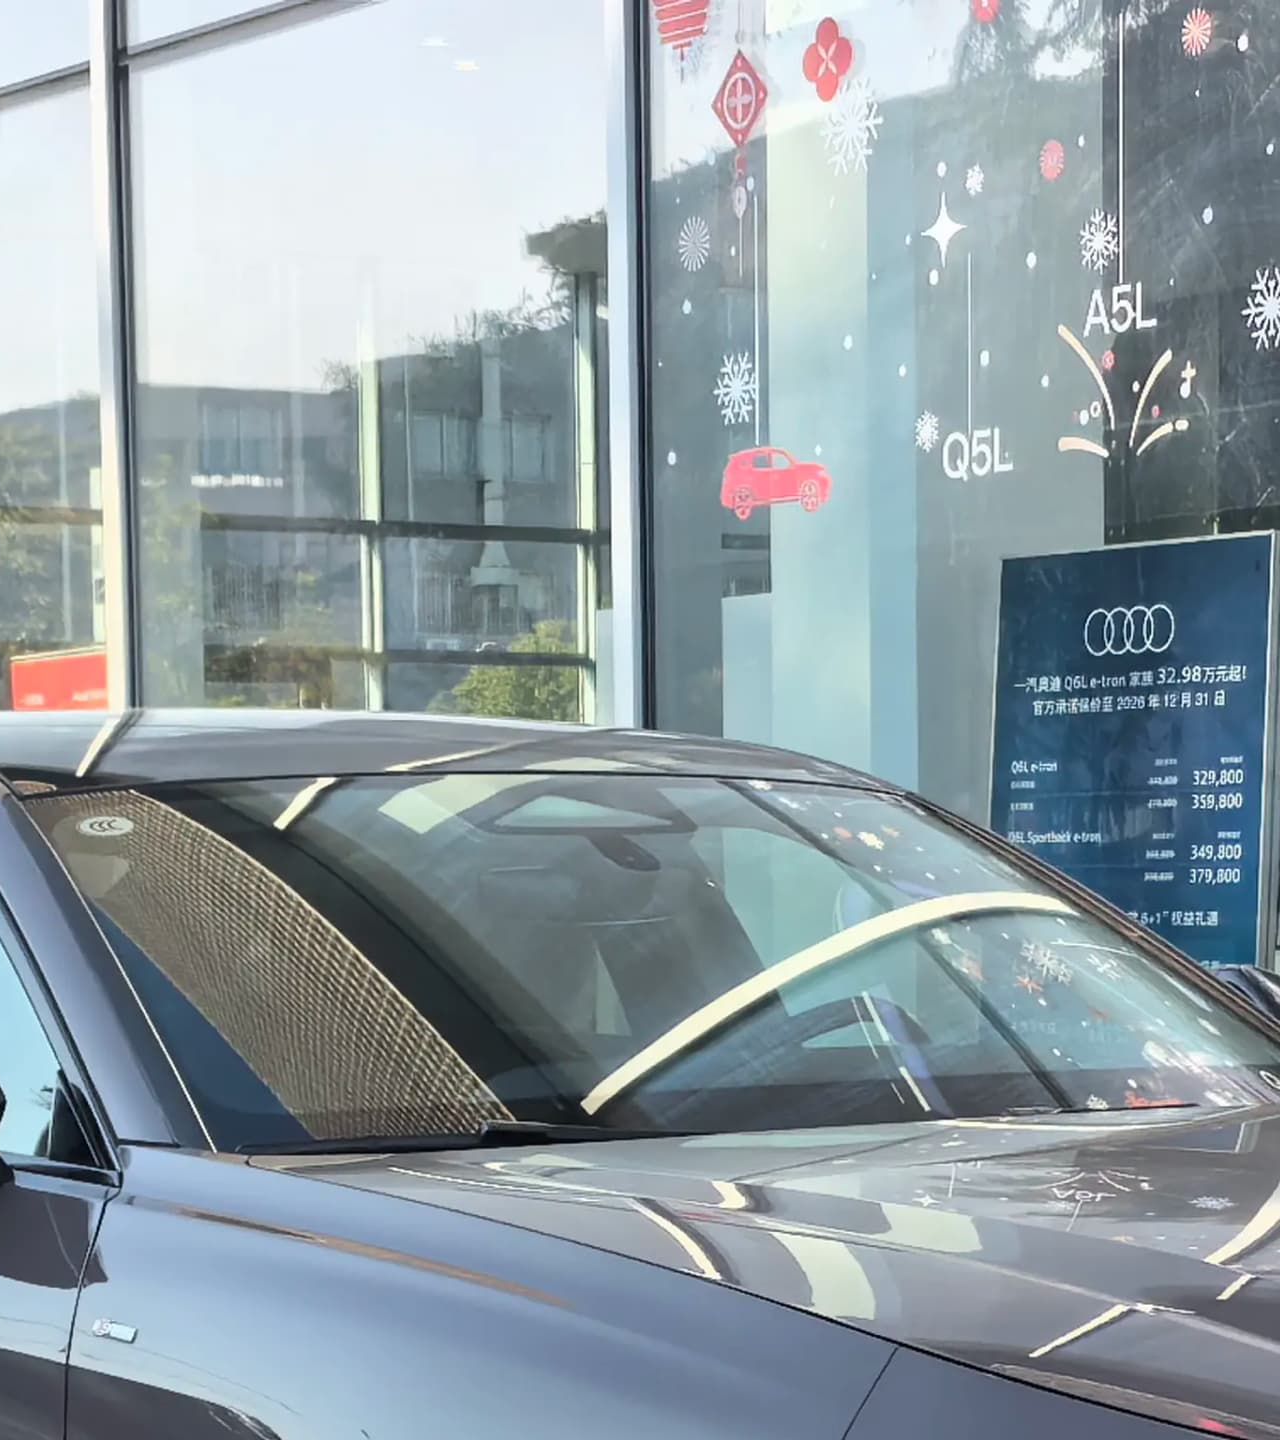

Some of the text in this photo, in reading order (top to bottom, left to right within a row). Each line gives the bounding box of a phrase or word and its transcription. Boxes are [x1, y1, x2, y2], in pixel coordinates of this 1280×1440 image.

[1083, 281, 1158, 338] A5L
[942, 427, 1013, 482] Q5L
[1064, 675, 1088, 691] Q6L
[1090, 674, 1126, 690] e-tron
[1192, 769, 1244, 787] 329,800
[1191, 792, 1243, 811] 359,800
[1190, 844, 1242, 862] 349,800
[1189, 868, 1241, 886] 379,800
